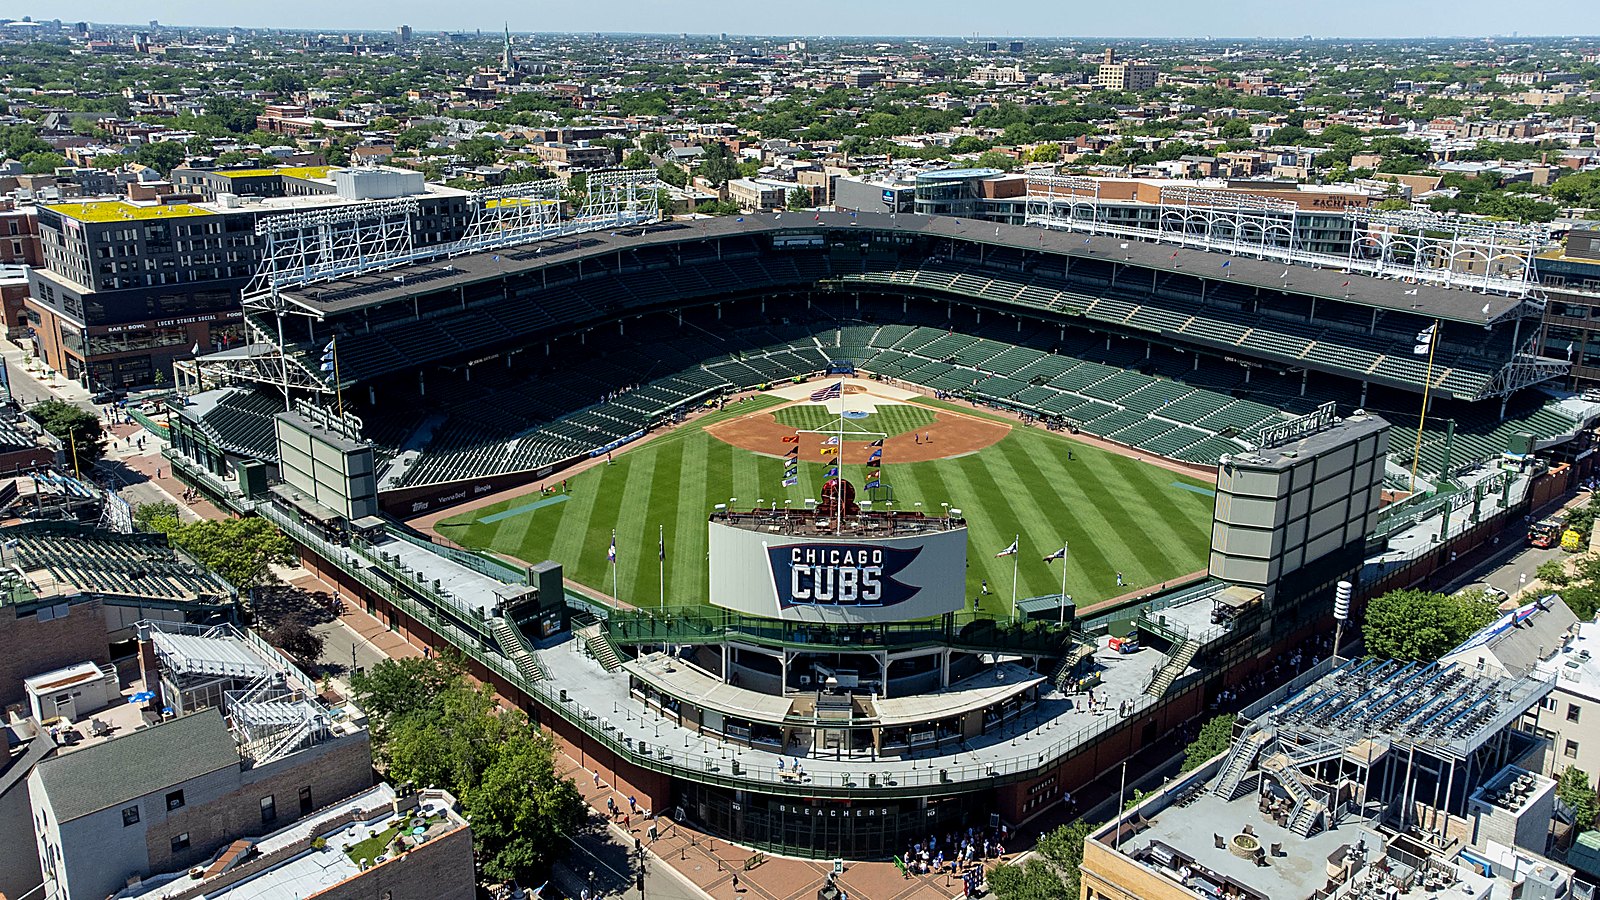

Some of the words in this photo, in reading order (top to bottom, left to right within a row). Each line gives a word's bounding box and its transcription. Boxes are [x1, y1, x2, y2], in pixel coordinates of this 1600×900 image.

[1313, 199, 1361, 208] ZACHARY
[157, 319, 175, 327] LUCKY
[176, 317, 196, 325] STRIKE
[198, 314, 217, 322] SOCIAL
[791, 547, 882, 564] CHICAGO
[791, 563, 882, 601] CUBS
[779, 804, 888, 817] BLEACHERS
